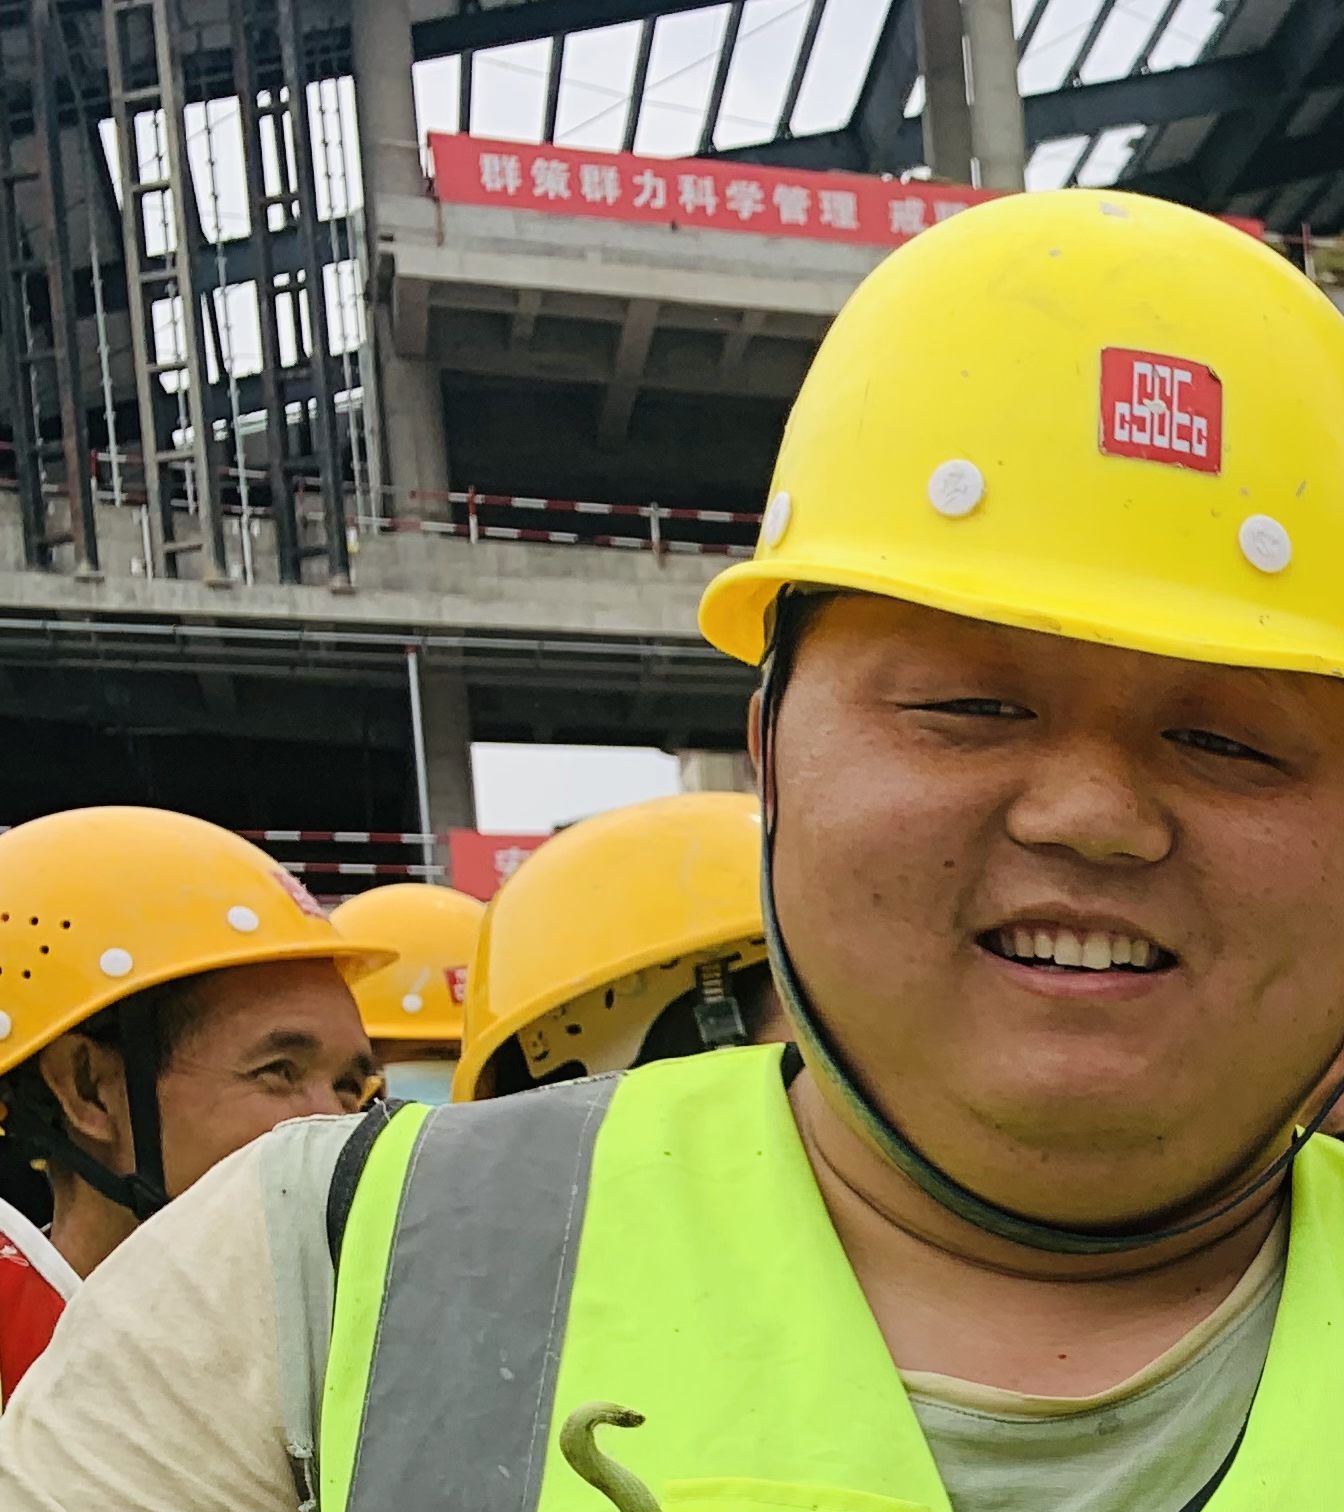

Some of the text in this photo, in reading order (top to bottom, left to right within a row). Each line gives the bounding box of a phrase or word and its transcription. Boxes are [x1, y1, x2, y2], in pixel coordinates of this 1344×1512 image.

[479, 152, 860, 230] 群策群力科学管理
